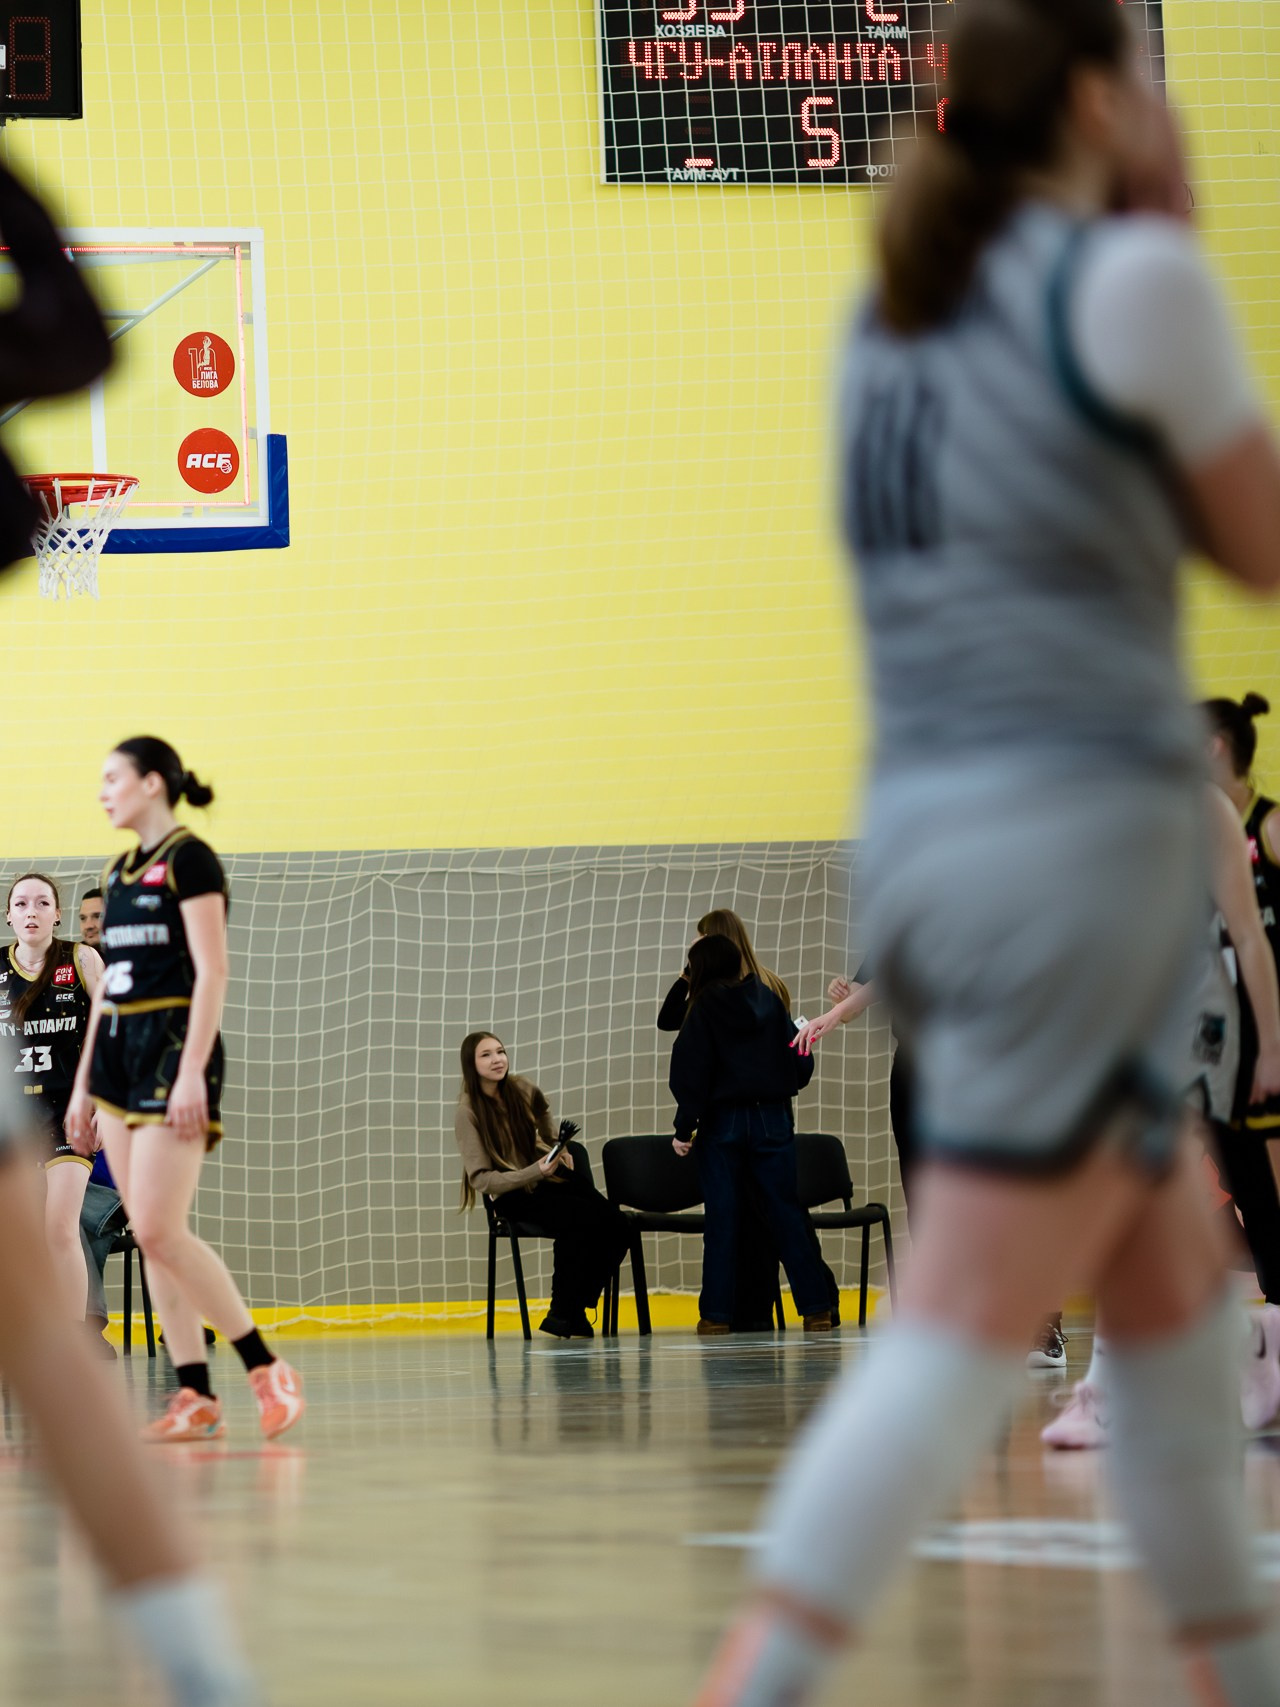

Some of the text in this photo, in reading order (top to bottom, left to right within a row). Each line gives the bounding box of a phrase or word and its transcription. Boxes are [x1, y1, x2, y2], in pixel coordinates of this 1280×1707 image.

[655, 24, 727, 38] ХОЗЯЕВА
[865, 25, 907, 40] ТАЙМ
[628, 41, 901, 81] ЧГУ-АТЛАНТА
[664, 166, 739, 182] ТАЙМ-АУТ
[200, 370, 218, 380] ЛИГА
[55, 966, 73, 975] FON
[55, 973, 73, 982] BET
[14, 1045, 53, 1073] 33
